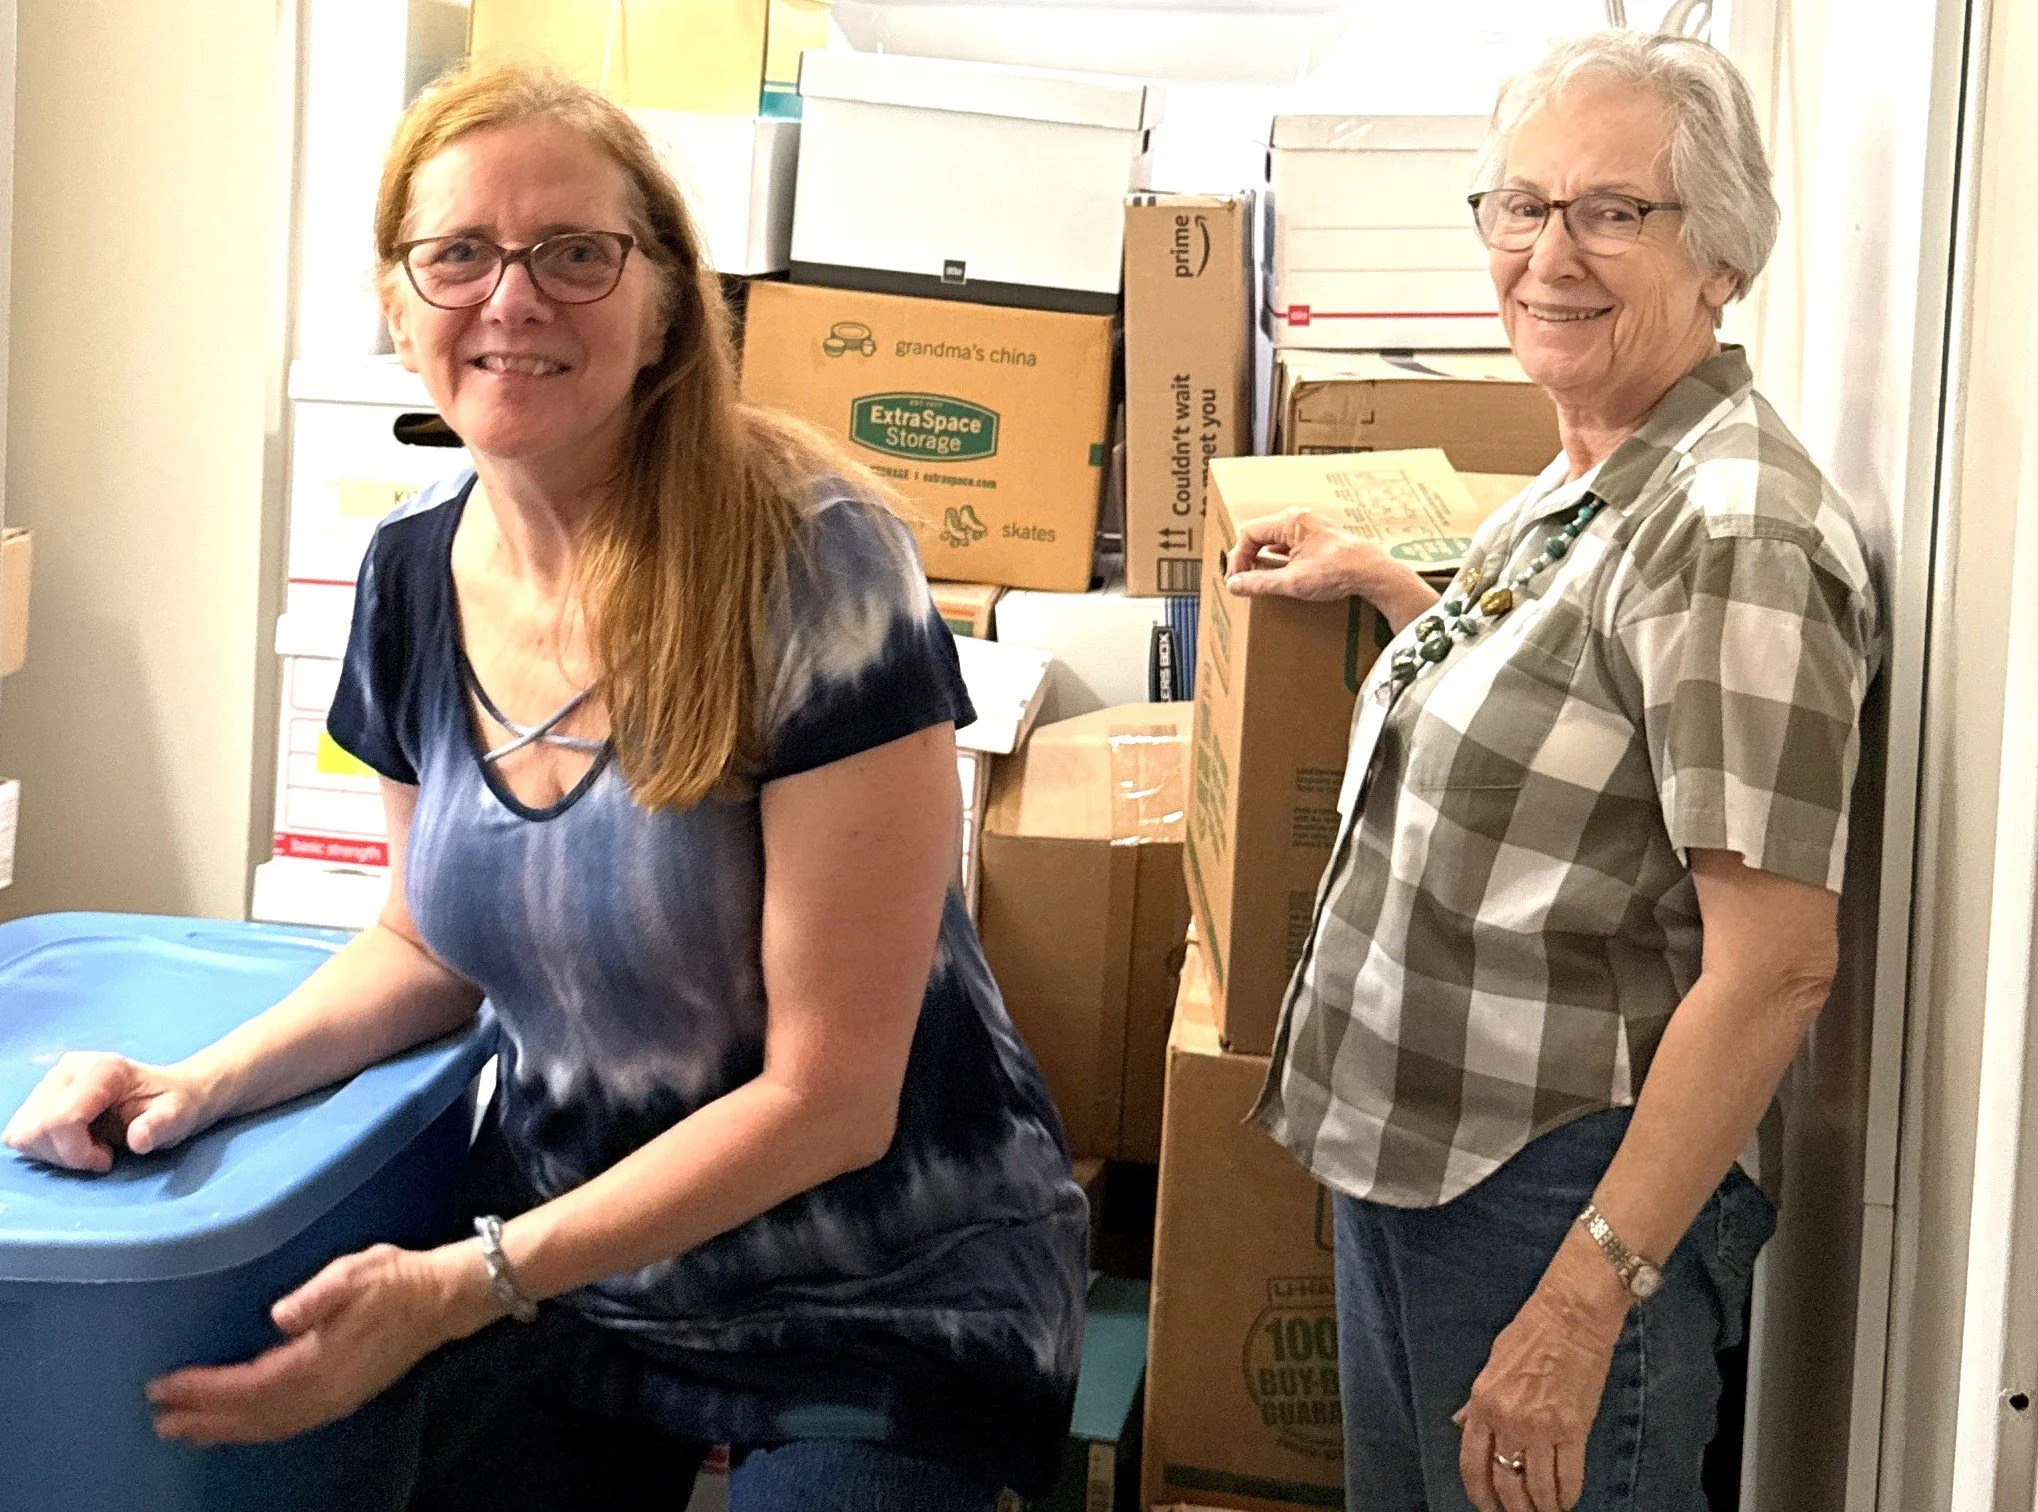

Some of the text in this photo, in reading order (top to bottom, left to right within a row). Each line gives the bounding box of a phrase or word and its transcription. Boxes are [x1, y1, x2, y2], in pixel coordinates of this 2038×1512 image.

[1170, 214, 1193, 277] prime
[895, 340, 1038, 367] grandma's china
[870, 405, 982, 434] ExtraSpace
[1202, 389, 1221, 428] you
[886, 426, 961, 454] Storage
[1171, 374, 1191, 516] Couldn't wait
[1001, 521, 1056, 543] skates
[1264, 1316, 1338, 1362] 100
